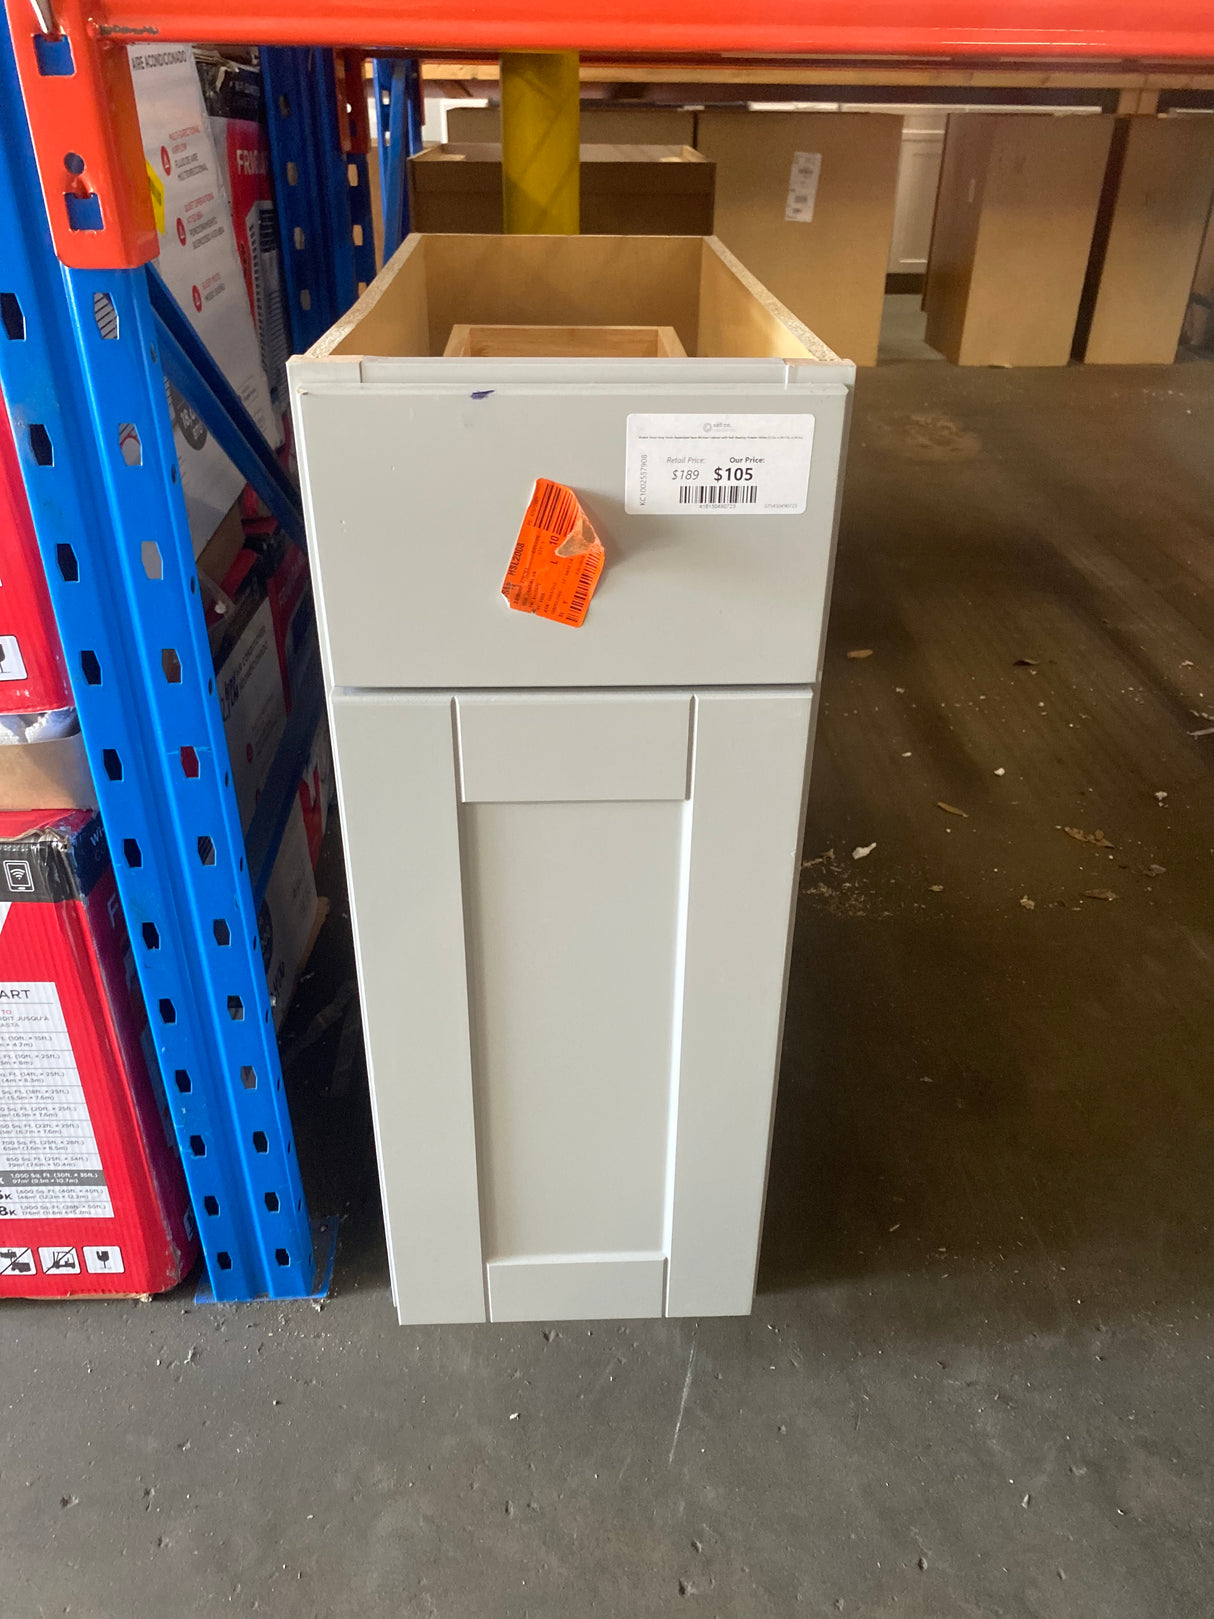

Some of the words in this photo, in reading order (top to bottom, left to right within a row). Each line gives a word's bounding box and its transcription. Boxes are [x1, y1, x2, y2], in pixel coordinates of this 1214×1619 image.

[666, 456, 686, 464] Retail
[687, 456, 706, 464] Price:
[672, 469, 700, 481] $189
[714, 466, 753, 483] $105
